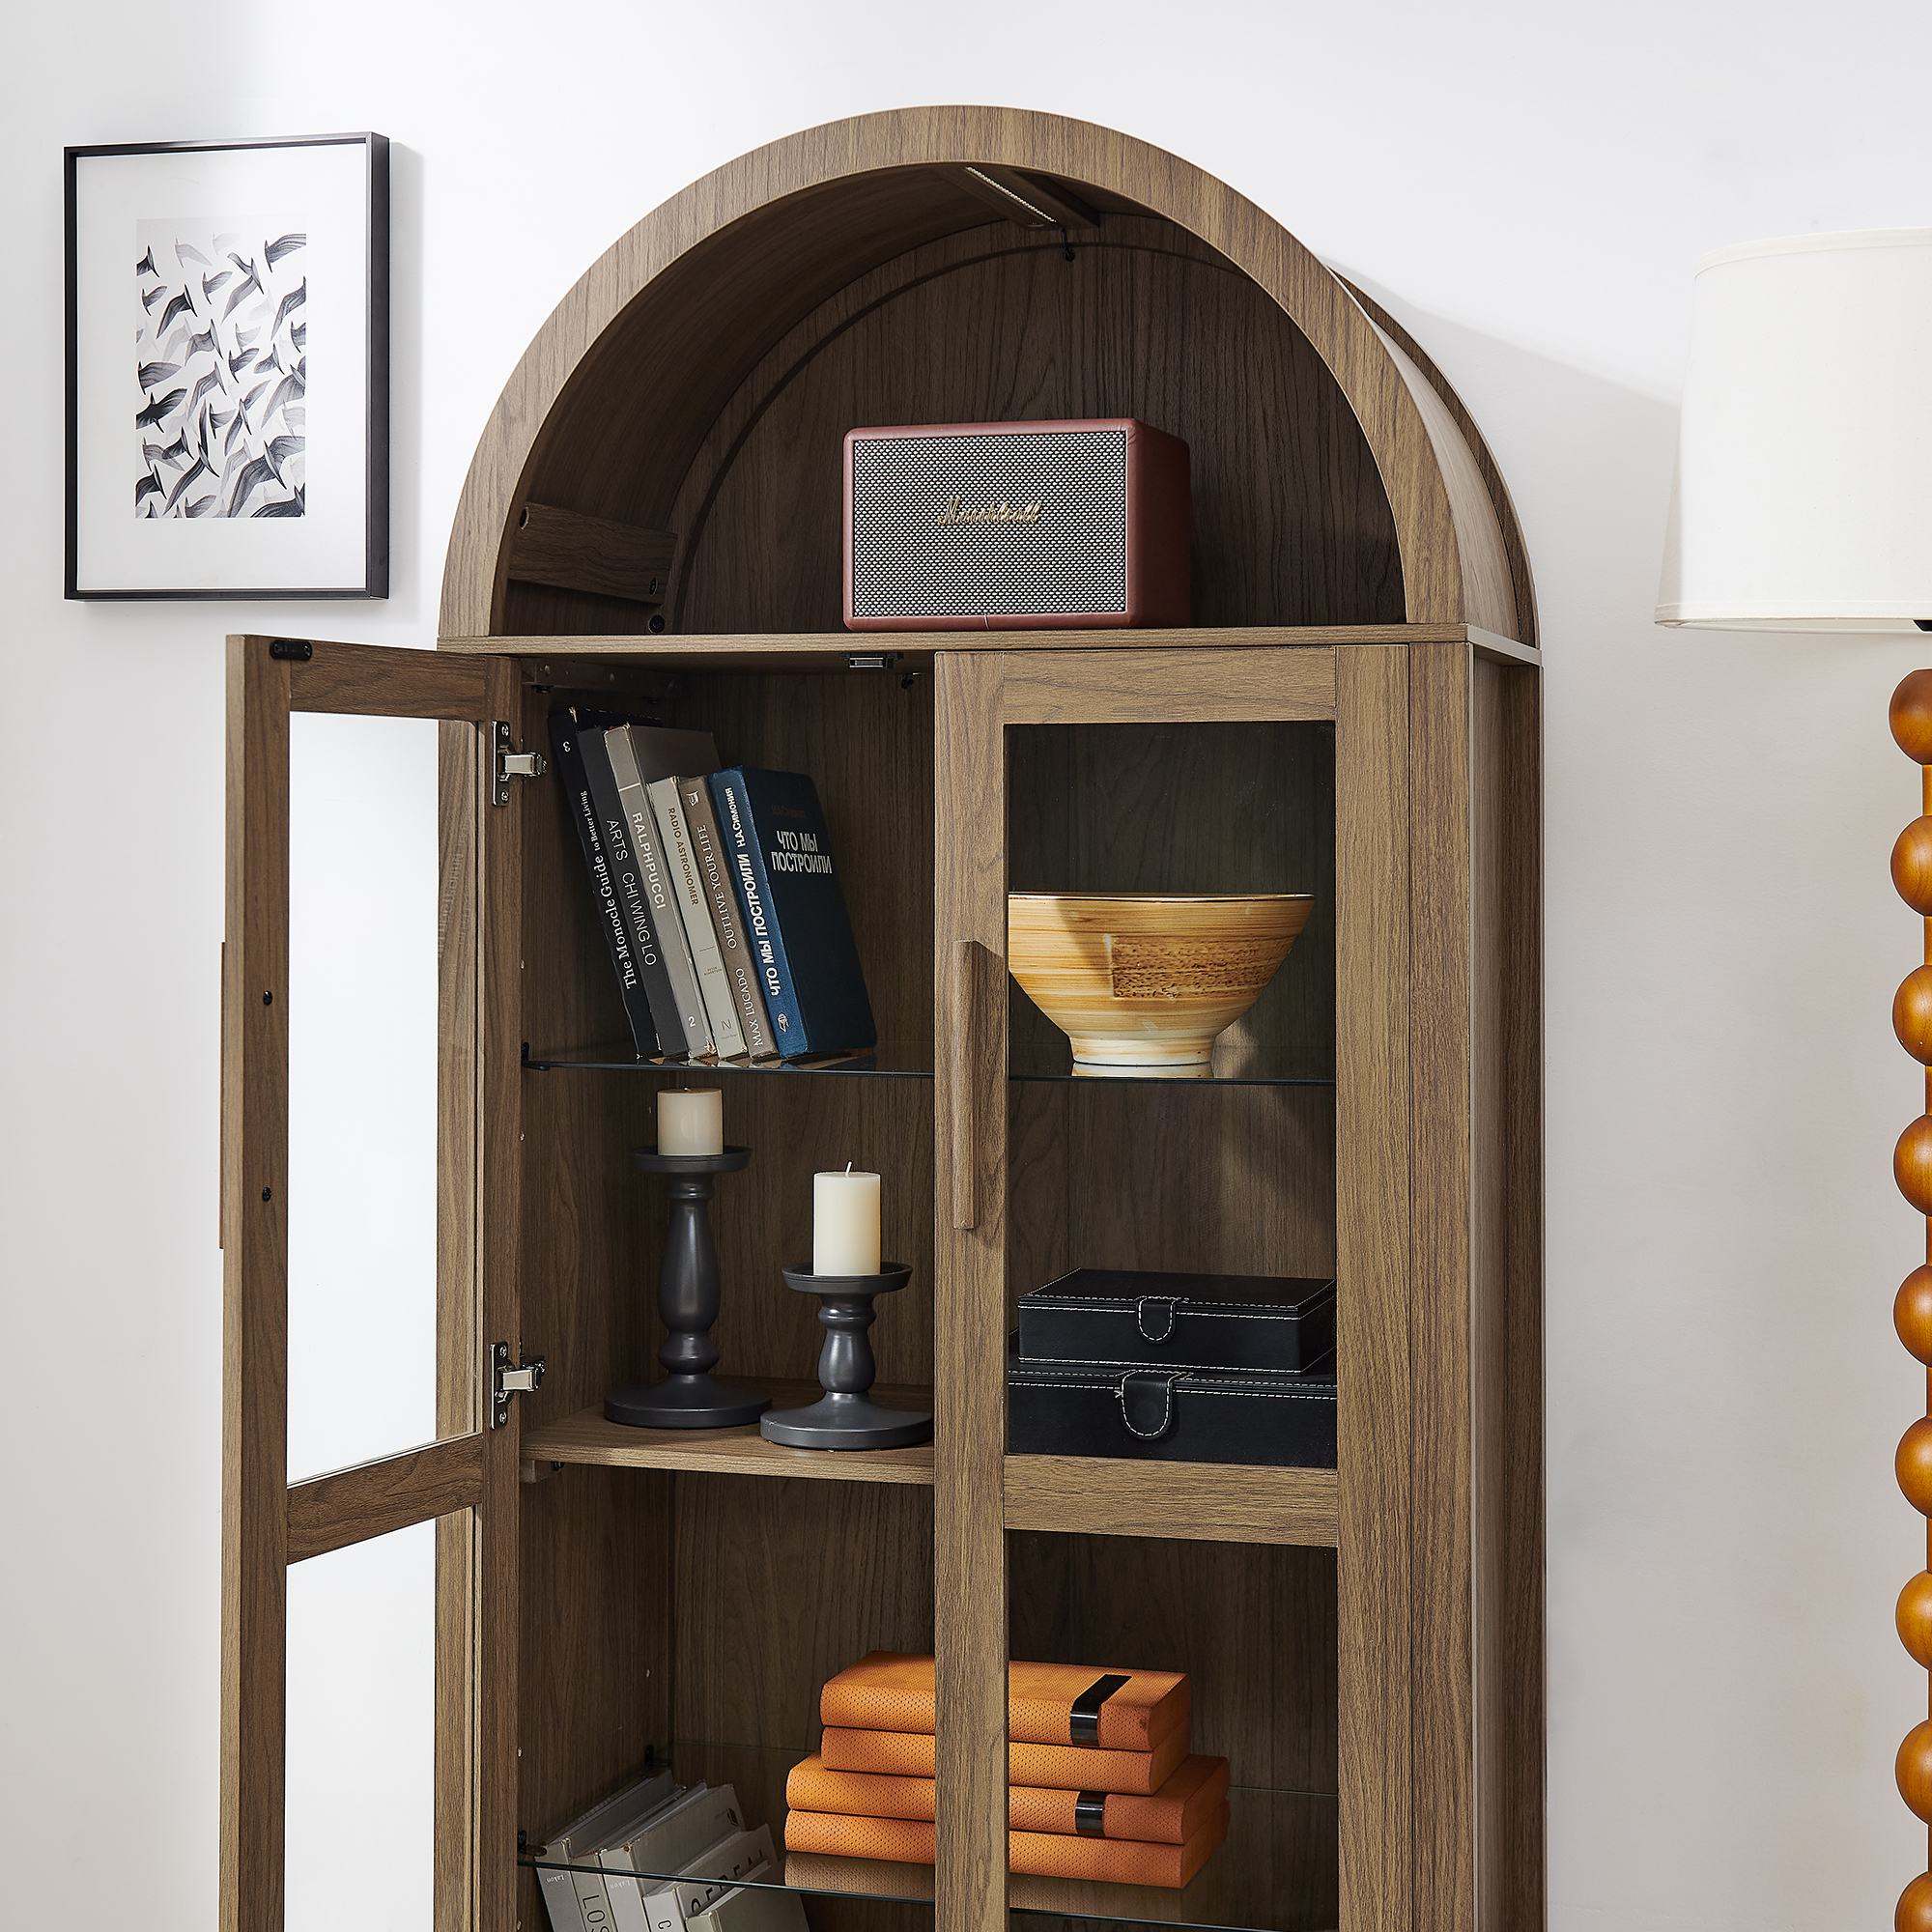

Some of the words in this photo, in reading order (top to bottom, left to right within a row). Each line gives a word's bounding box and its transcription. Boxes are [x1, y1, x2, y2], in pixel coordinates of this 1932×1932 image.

[938, 496, 1042, 526] Marshall
[581, 791, 591, 816] Living
[587, 817, 599, 839] Better
[607, 820, 628, 861] ARTS
[696, 824, 712, 852] LIFE
[776, 830, 799, 851] ЧТО
[799, 832, 819, 852] МЫ
[593, 839, 601, 851] to
[668, 808, 682, 838] RADIO
[676, 841, 699, 906] ASTRONOMER
[632, 811, 667, 909] RALPHPUCCI
[705, 852, 722, 890] YOUR
[771, 851, 833, 874] ПОСТРОИЛИ
[594, 855, 612, 897] Guide
[622, 872, 639, 898] CHI
[736, 853, 769, 937] ПОСТРОИЛИ
[606, 898, 630, 960] Monocle
[630, 899, 651, 943] WING
[715, 892, 737, 949] OUTLIVE
[640, 944, 657, 966] LO
[758, 940, 776, 964] МЫ
[623, 961, 637, 989] The
[766, 967, 781, 996] ЧТО
[735, 968, 755, 1016] LUCADO
[688, 1016, 696, 1028] 2
[749, 1019, 763, 1046] MAX
